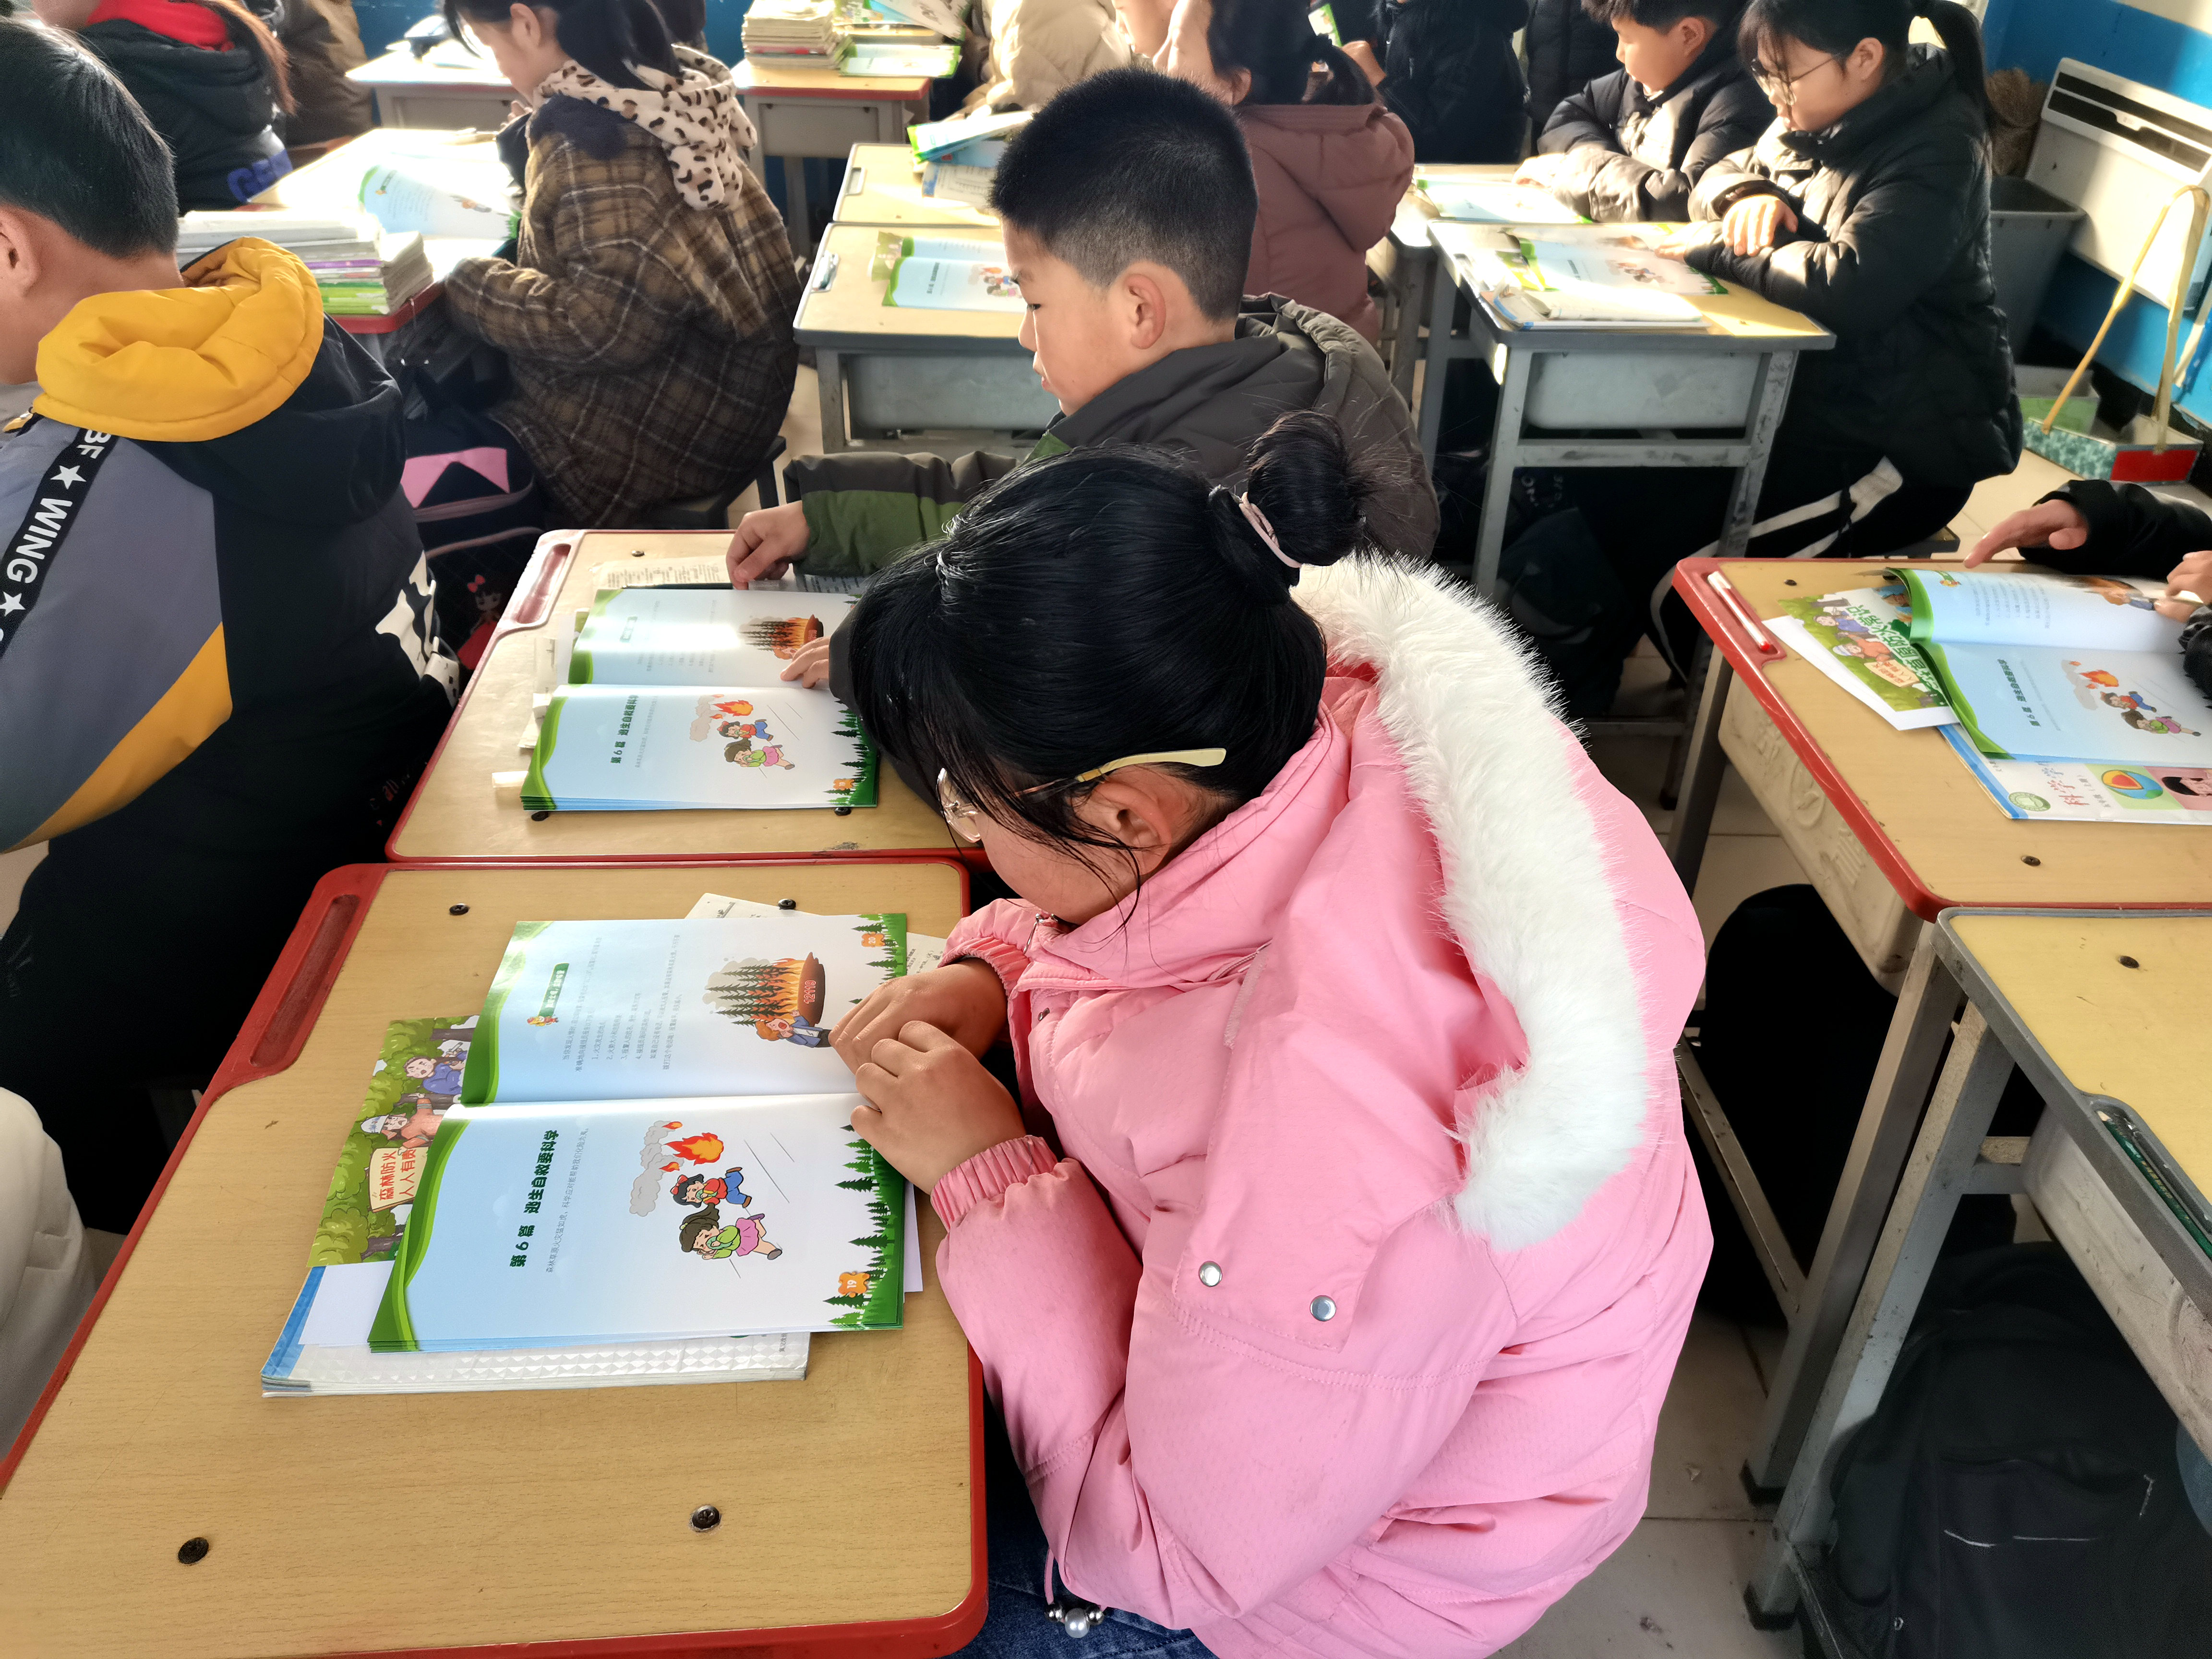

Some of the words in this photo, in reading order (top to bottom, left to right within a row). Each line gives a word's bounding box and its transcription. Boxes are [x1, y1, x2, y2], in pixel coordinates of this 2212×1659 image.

[6, 498, 73, 584] WING
[1846, 605, 1938, 690] 草原防火常识
[2047, 780, 2090, 806] 科学
[803, 980, 817, 1004] 12119
[378, 1151, 397, 1201] 森林防火
[398, 1149, 416, 1197] 人人有责
[509, 1225, 535, 1267] 第6篇
[523, 1130, 559, 1214] 逃生自救要科学
[847, 1280, 857, 1289] 19
